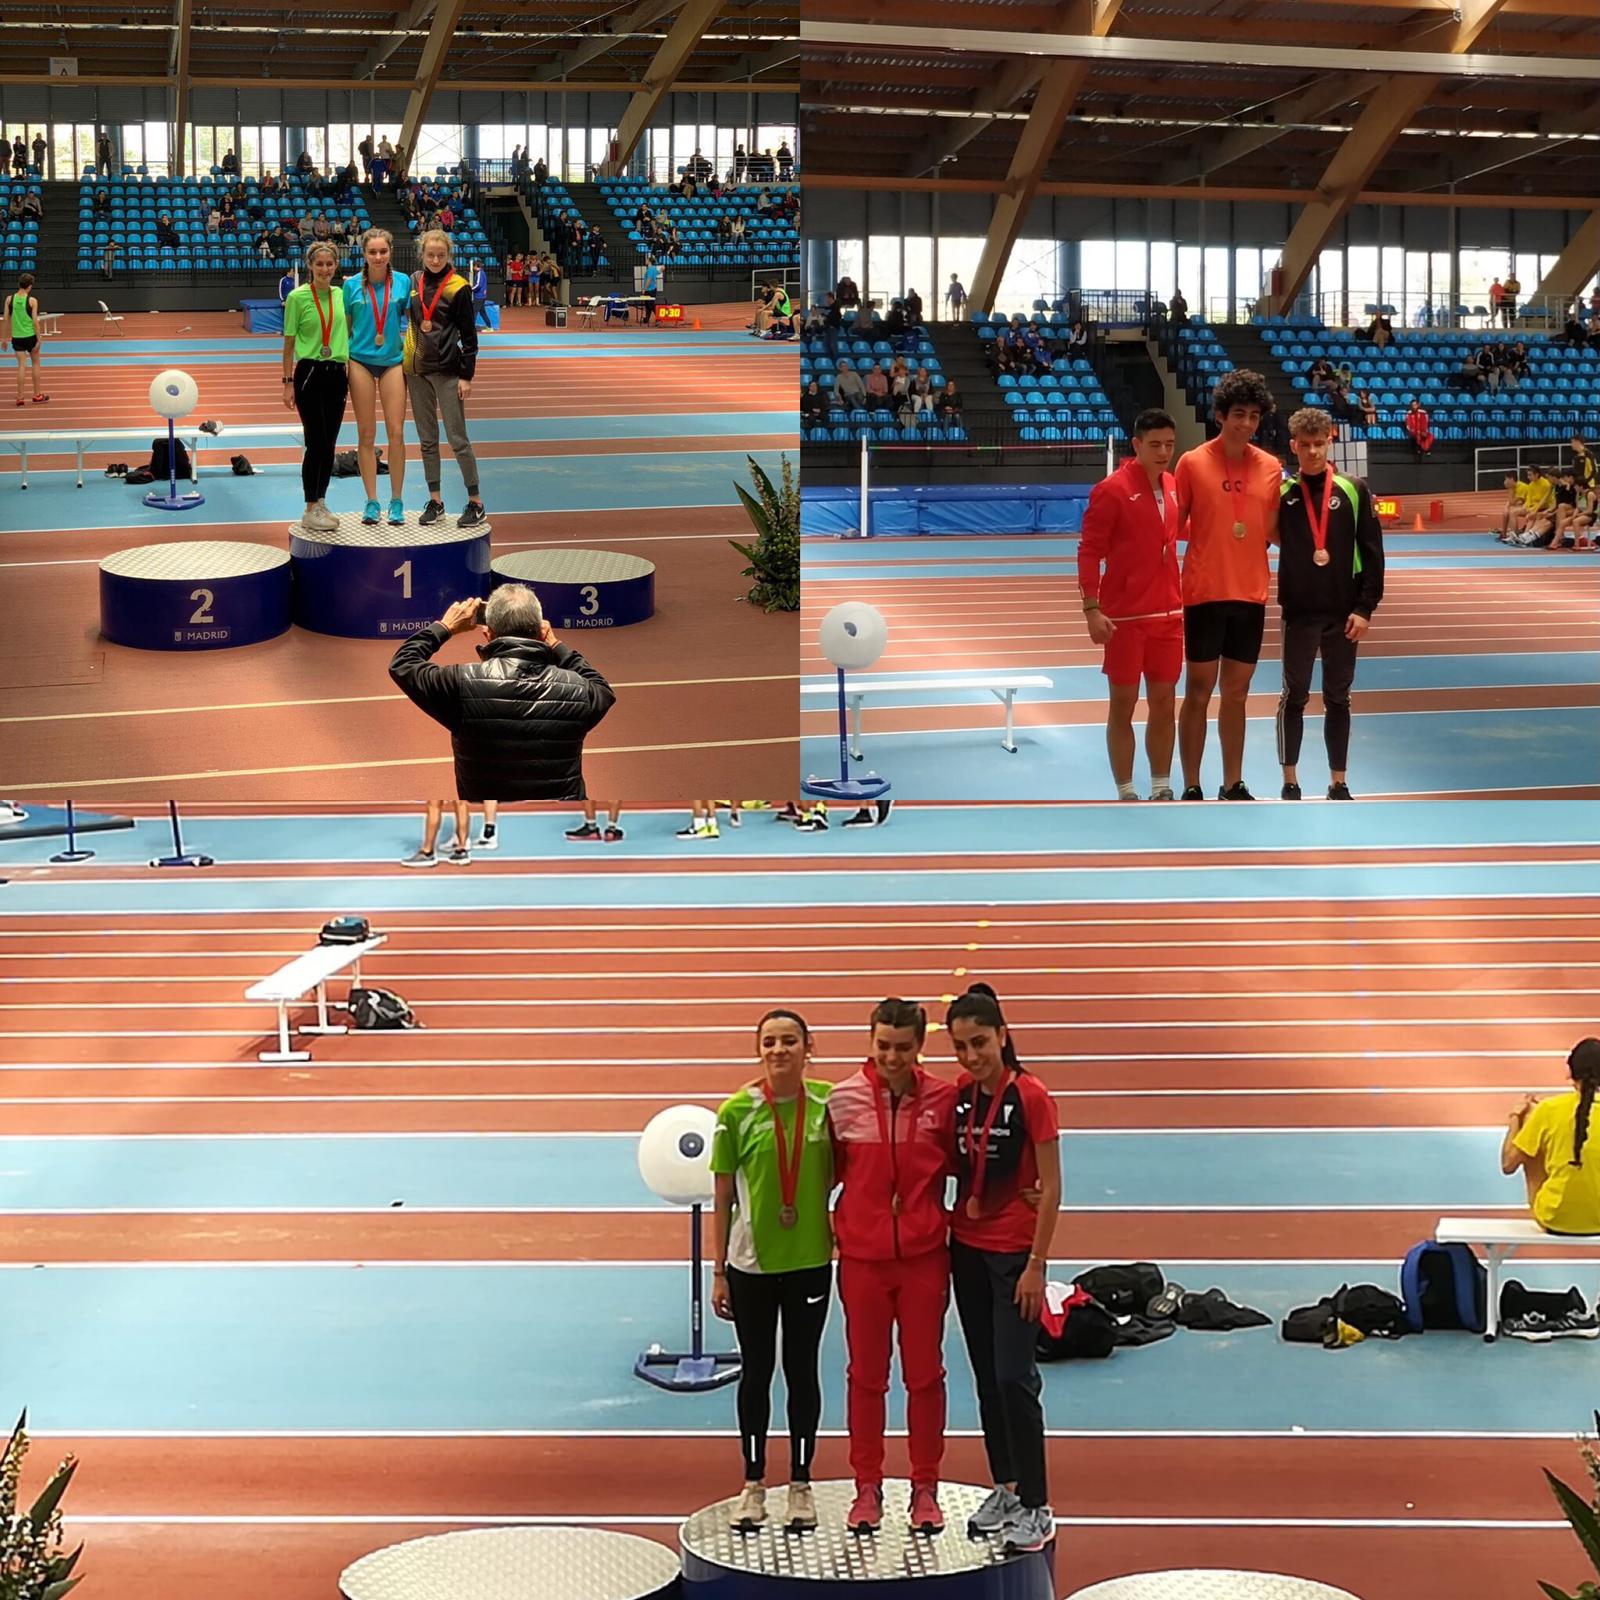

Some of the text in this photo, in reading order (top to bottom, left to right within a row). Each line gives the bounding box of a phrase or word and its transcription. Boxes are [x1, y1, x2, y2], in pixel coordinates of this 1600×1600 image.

[659, 308, 681, 318] 0:30
[393, 560, 412, 599] 1
[189, 588, 214, 624] 2
[579, 585, 600, 616] 3
[392, 621, 432, 631] MADRID
[576, 617, 614, 627] MADRID
[187, 630, 229, 641] MADRID
